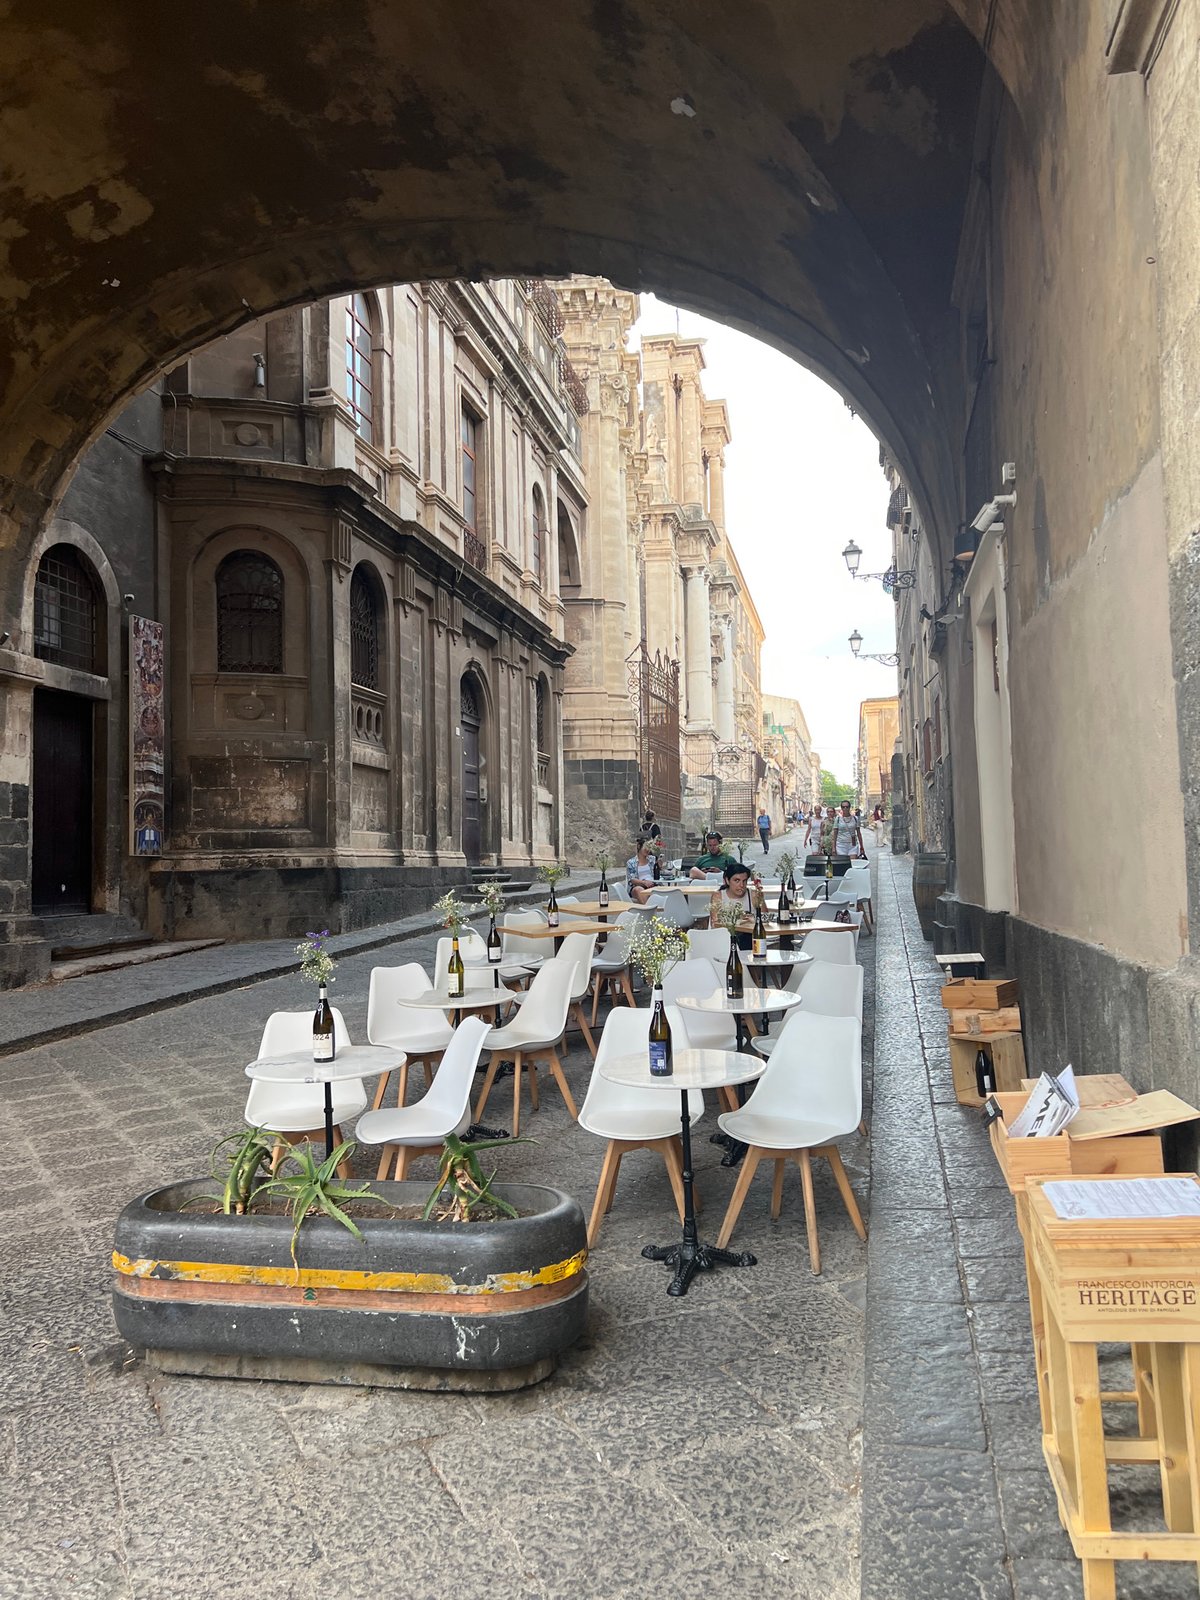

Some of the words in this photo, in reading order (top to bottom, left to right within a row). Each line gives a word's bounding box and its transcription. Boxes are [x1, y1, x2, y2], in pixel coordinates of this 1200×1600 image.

[1077, 1280, 1140, 1289] FRANCESCO
[1142, 1280, 1194, 1289] INTORCIA
[1079, 1290, 1196, 1306] HERITAGE
